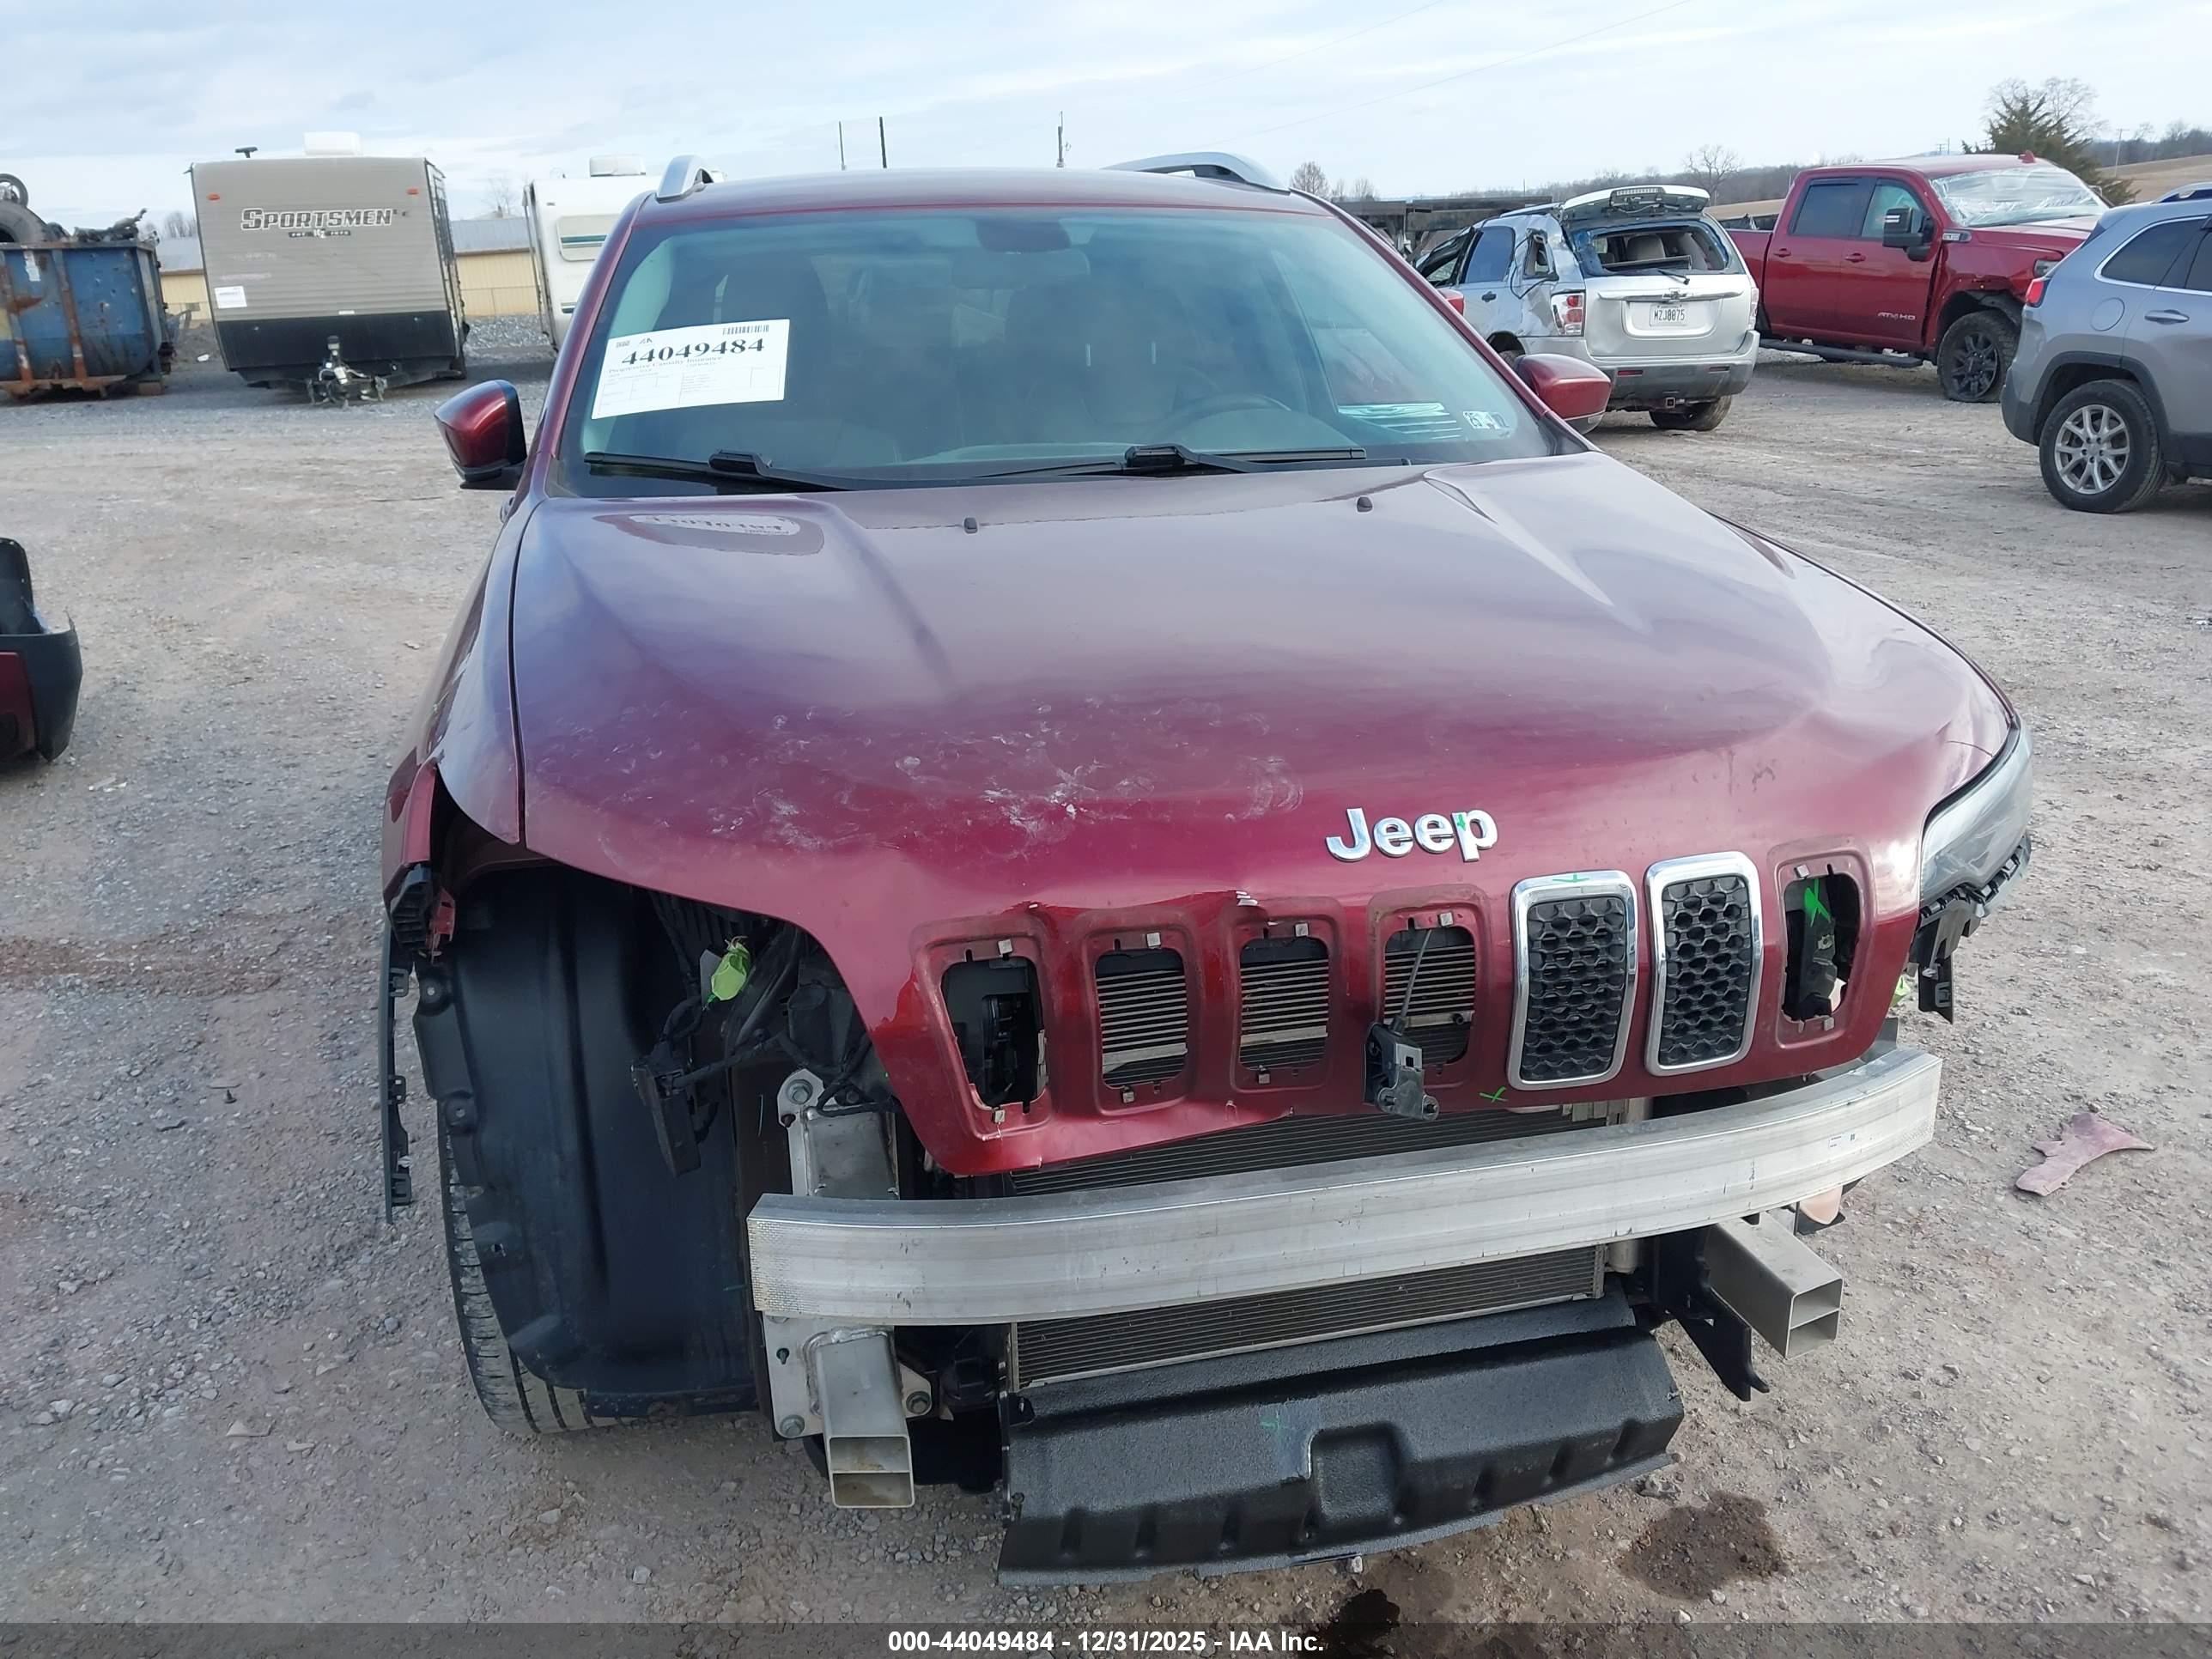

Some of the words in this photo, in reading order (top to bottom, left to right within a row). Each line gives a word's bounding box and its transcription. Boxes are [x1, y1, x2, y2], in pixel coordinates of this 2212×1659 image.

[241, 208, 392, 230] SPORTSMEN
[622, 337, 765, 365] 44049484
[1325, 807, 1498, 862] Jeep
